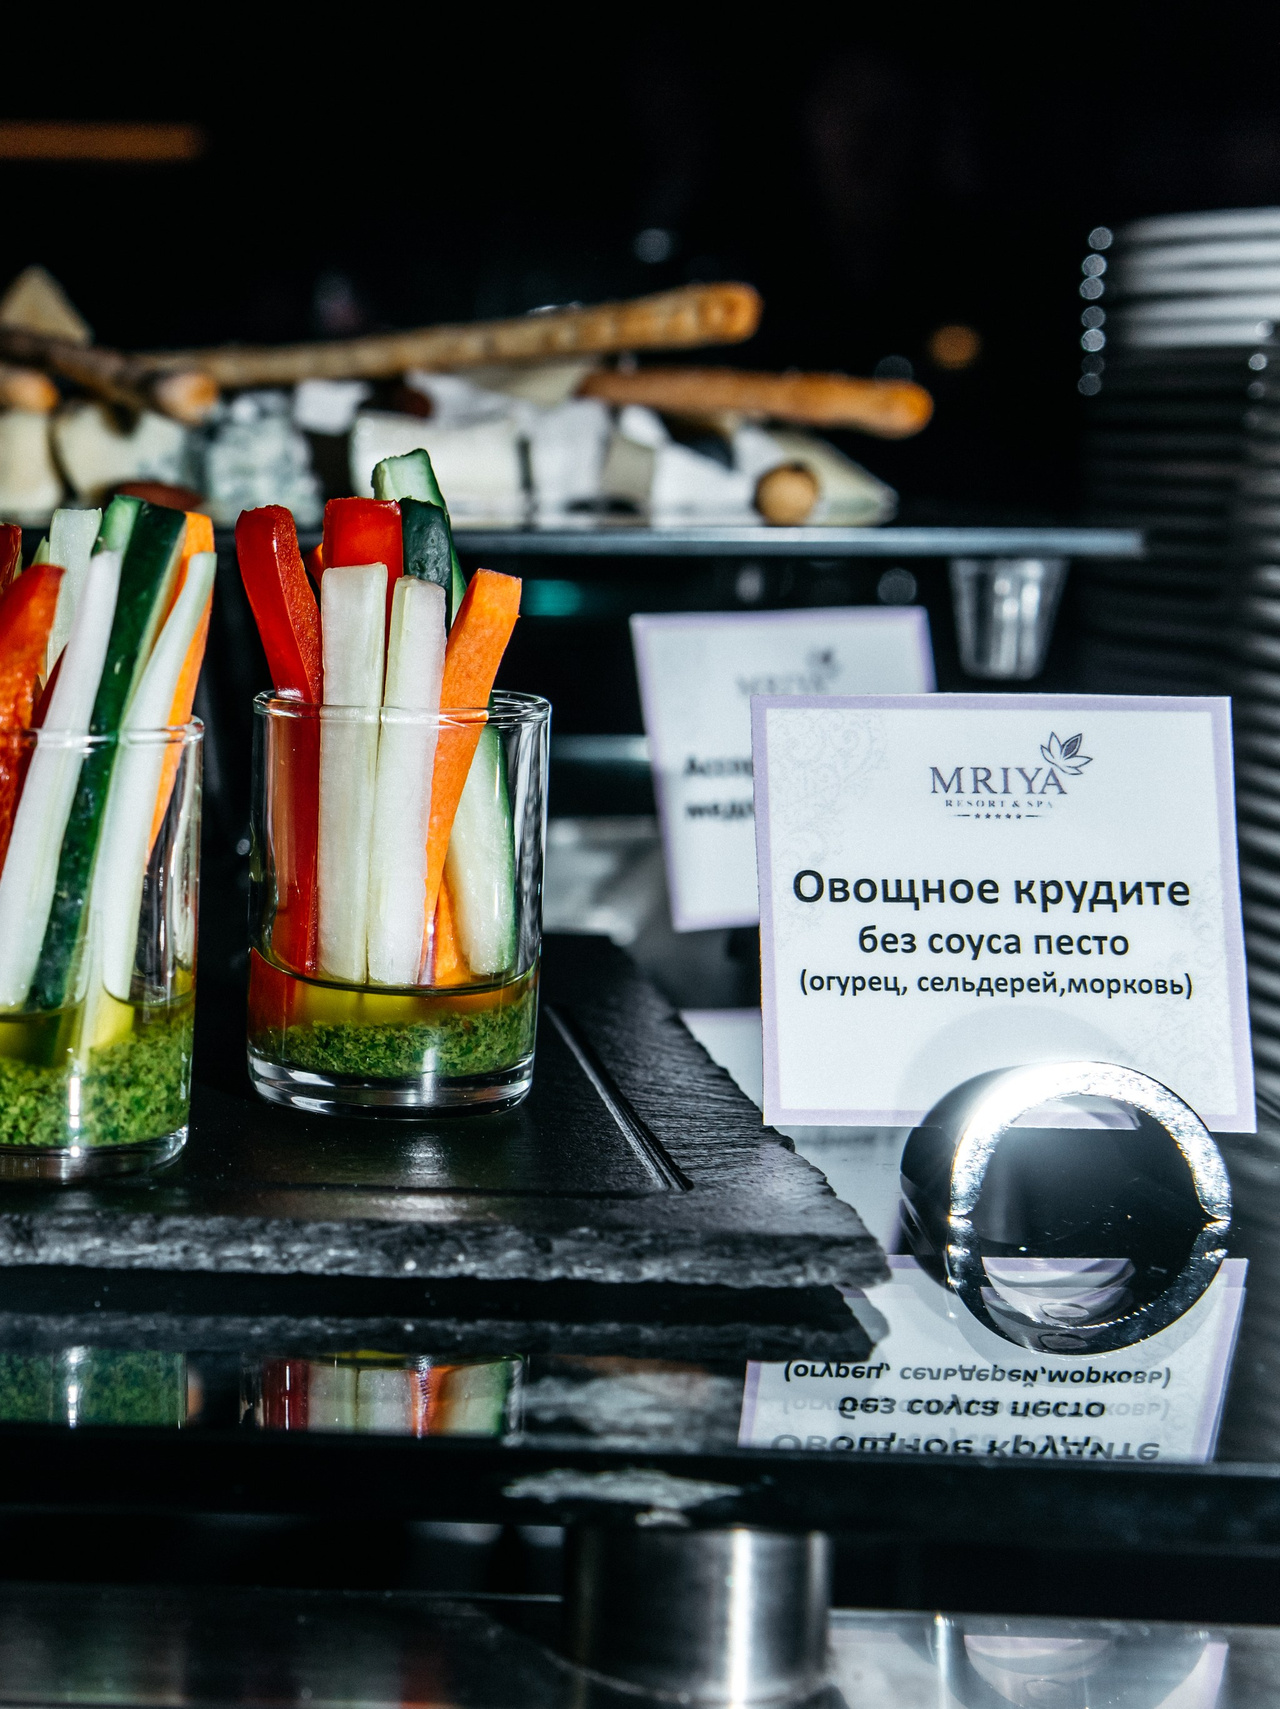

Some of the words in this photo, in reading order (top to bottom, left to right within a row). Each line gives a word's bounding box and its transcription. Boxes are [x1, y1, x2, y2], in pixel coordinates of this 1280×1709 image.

[929, 766, 1068, 795] MRIYA
[792, 869, 1000, 912] Овощное
[1014, 879, 1191, 913] крудите
[858, 925, 917, 954] без
[927, 934, 1022, 961] соуса
[1033, 935, 1130, 956] песто
[799, 968, 908, 997] (огурец,
